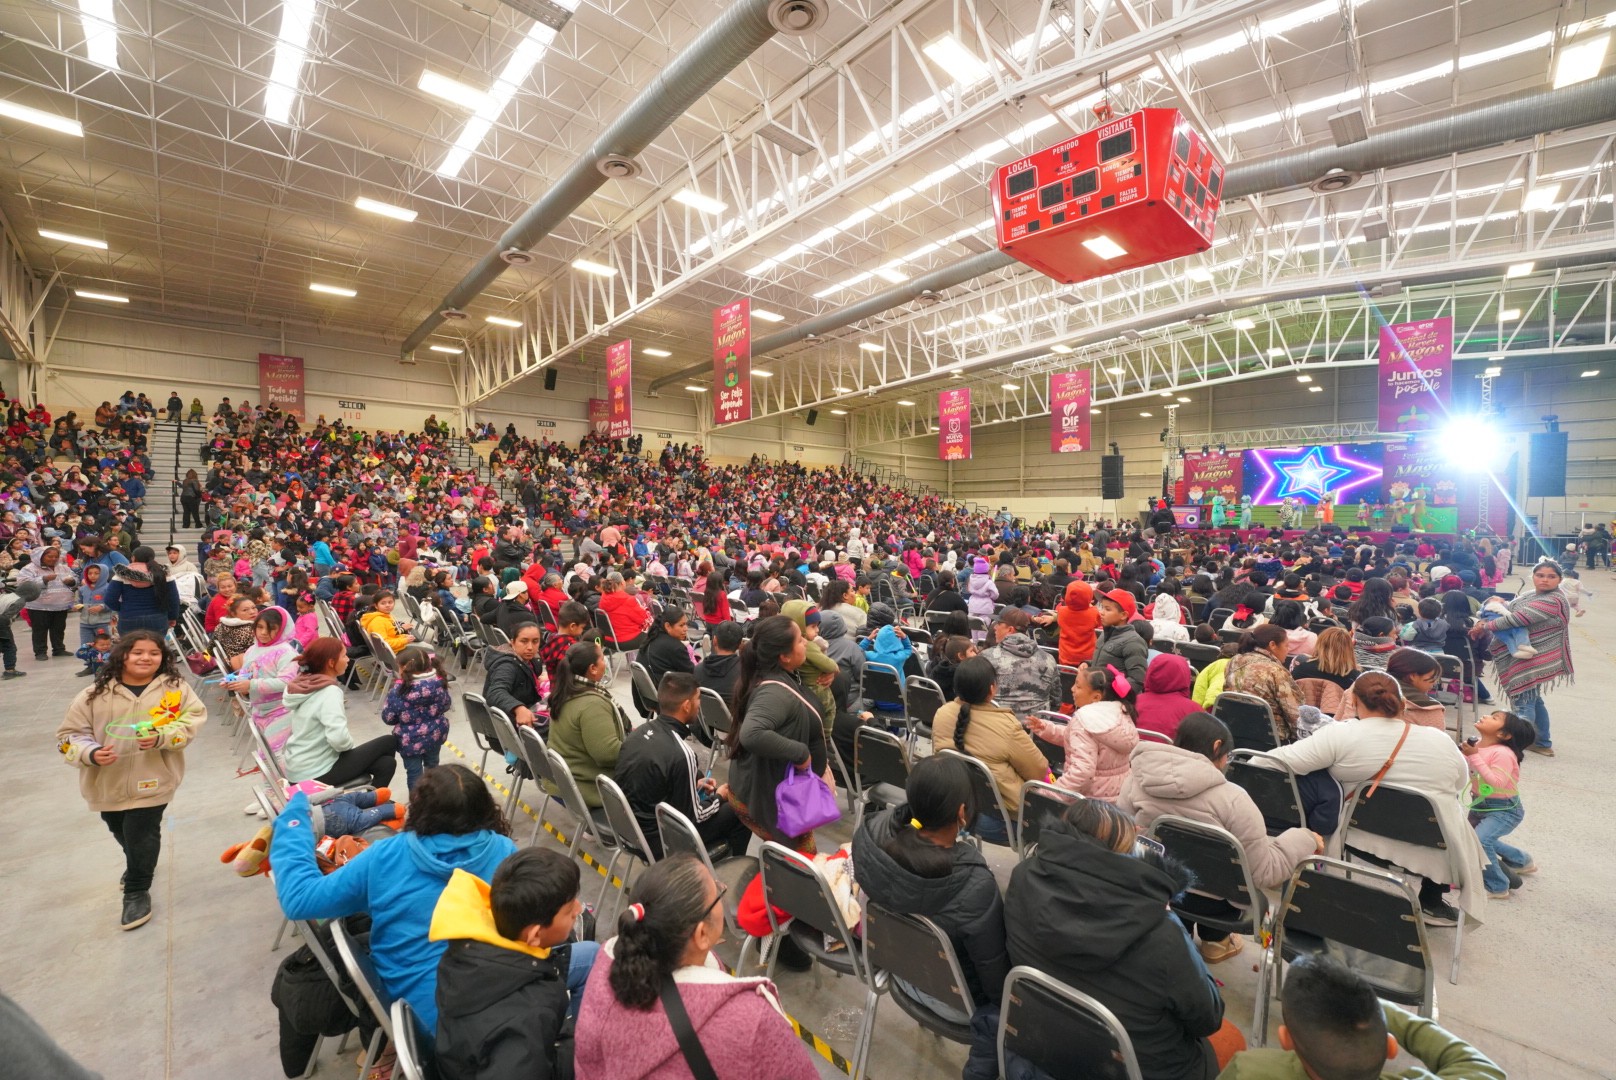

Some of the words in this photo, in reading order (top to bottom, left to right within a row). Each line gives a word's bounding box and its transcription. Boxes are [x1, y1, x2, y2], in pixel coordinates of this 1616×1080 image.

[1097, 118, 1133, 139] VISITANTE
[1052, 140, 1079, 155] PERIODO
[1008, 158, 1033, 175] LOCAL
[1116, 172, 1134, 183] FUERA
[1120, 187, 1138, 198] FALTAS
[716, 328, 746, 349] Magos
[1387, 344, 1444, 364] Magos
[1387, 368, 1443, 382] Juntos
[268, 386, 286, 394] Todo
[720, 390, 730, 400] Ser
[731, 386, 742, 400] feliz
[1054, 388, 1087, 402] Magos
[1394, 378, 1441, 400] posible
[720, 397, 743, 412] depende
[942, 404, 968, 416] Magos
[343, 412, 360, 420] 110
[725, 410, 732, 420] de
[1062, 415, 1079, 427] DIF
[1192, 470, 1233, 483] Magos
